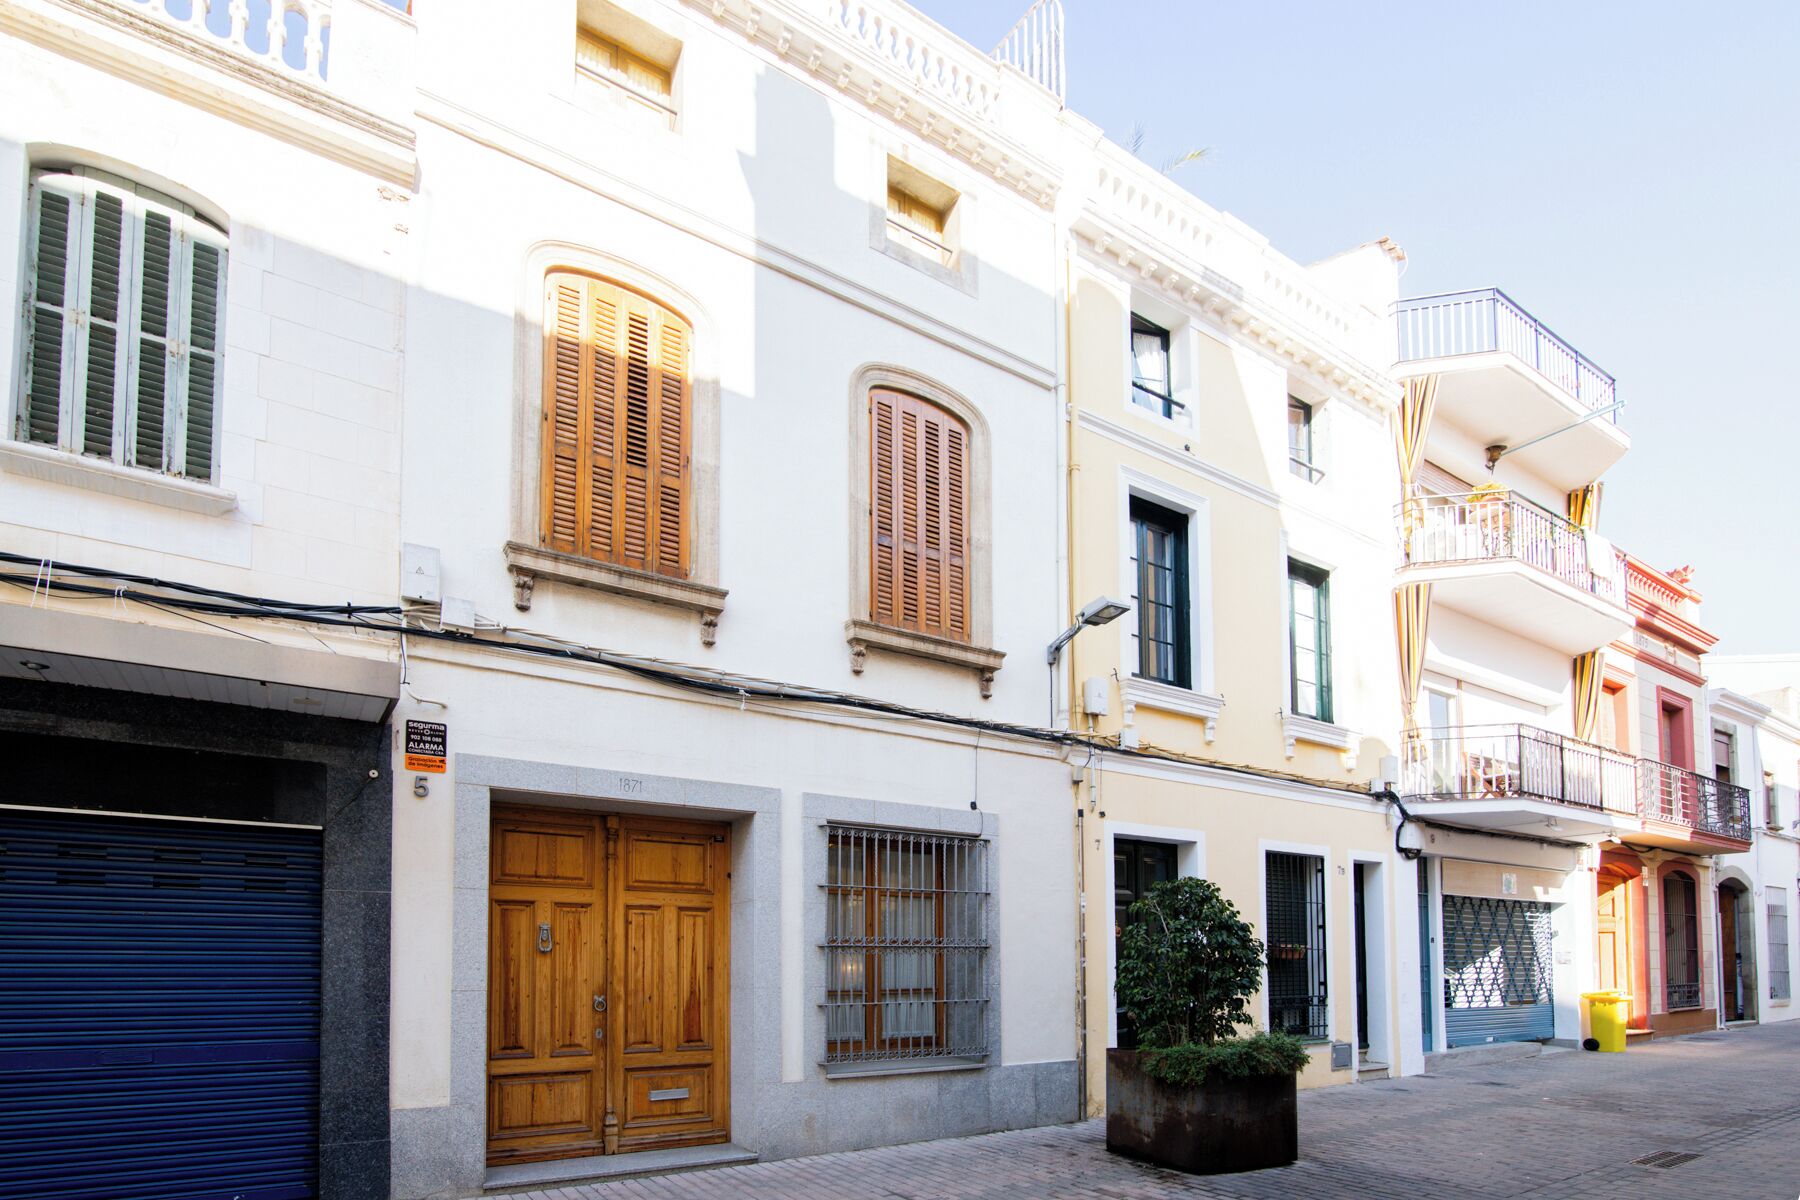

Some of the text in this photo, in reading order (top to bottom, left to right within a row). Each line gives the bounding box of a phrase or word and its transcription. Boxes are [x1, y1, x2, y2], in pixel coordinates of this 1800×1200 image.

[408, 722, 445, 730] segurma
[408, 742, 444, 751] ALARMA
[414, 775, 430, 798] 5
[619, 778, 642, 792] 1871
[1095, 839, 1101, 851] 7
